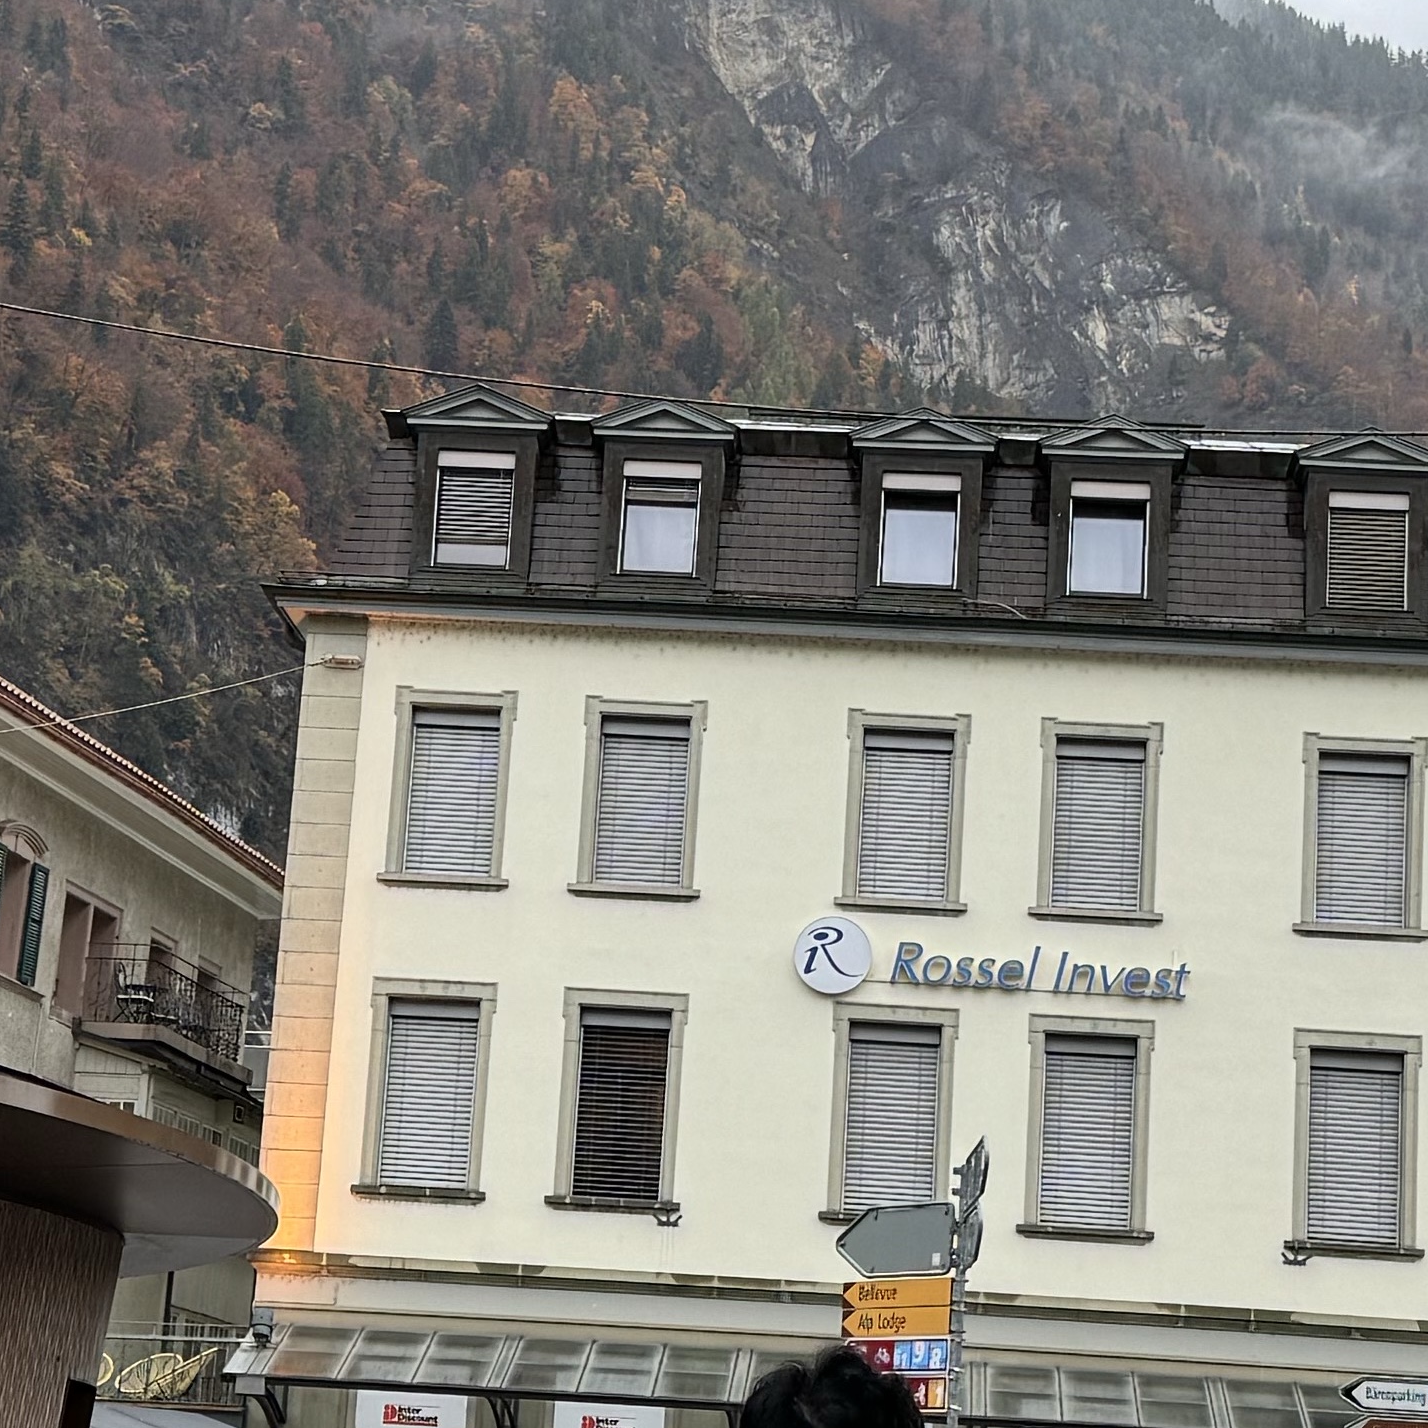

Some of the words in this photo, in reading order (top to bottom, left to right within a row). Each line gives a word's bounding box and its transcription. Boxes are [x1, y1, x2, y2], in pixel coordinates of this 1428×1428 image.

[890, 941, 1041, 992] Rossel
[1053, 951, 1191, 1000] Invest
[878, 1312, 907, 1333] Lodge
[398, 1406, 422, 1414] Inter
[398, 1414, 438, 1424] Discount
[596, 1417, 619, 1426] Inter
